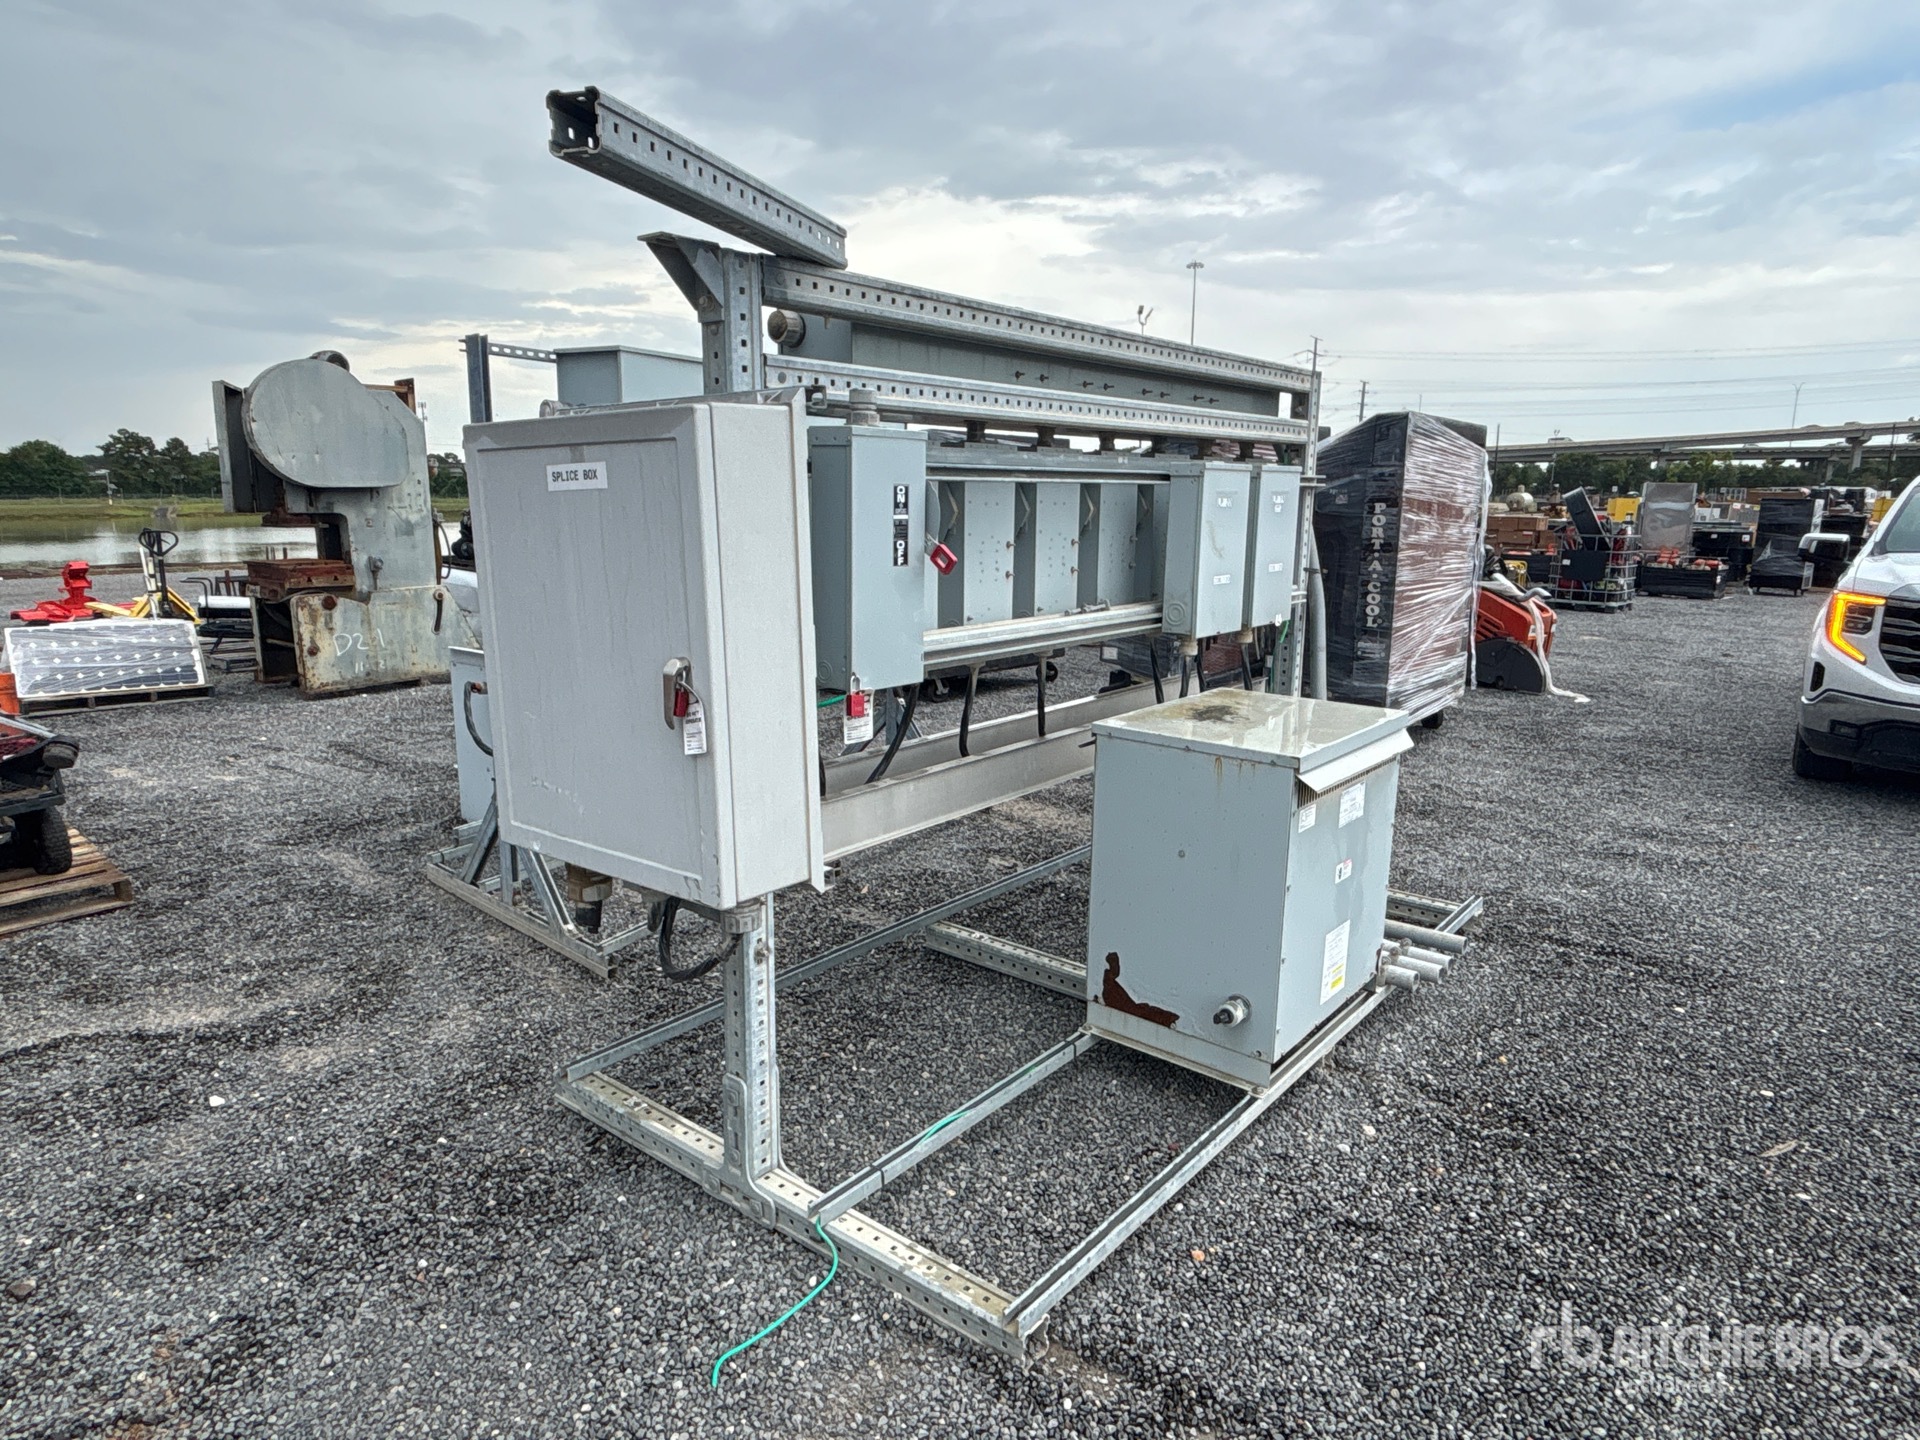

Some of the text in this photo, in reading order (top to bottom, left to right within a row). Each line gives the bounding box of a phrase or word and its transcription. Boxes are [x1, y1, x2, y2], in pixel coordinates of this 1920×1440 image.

[552, 469, 598, 482] SPLICE BOX
[896, 485, 906, 503] ON
[896, 540, 906, 566] OFF
